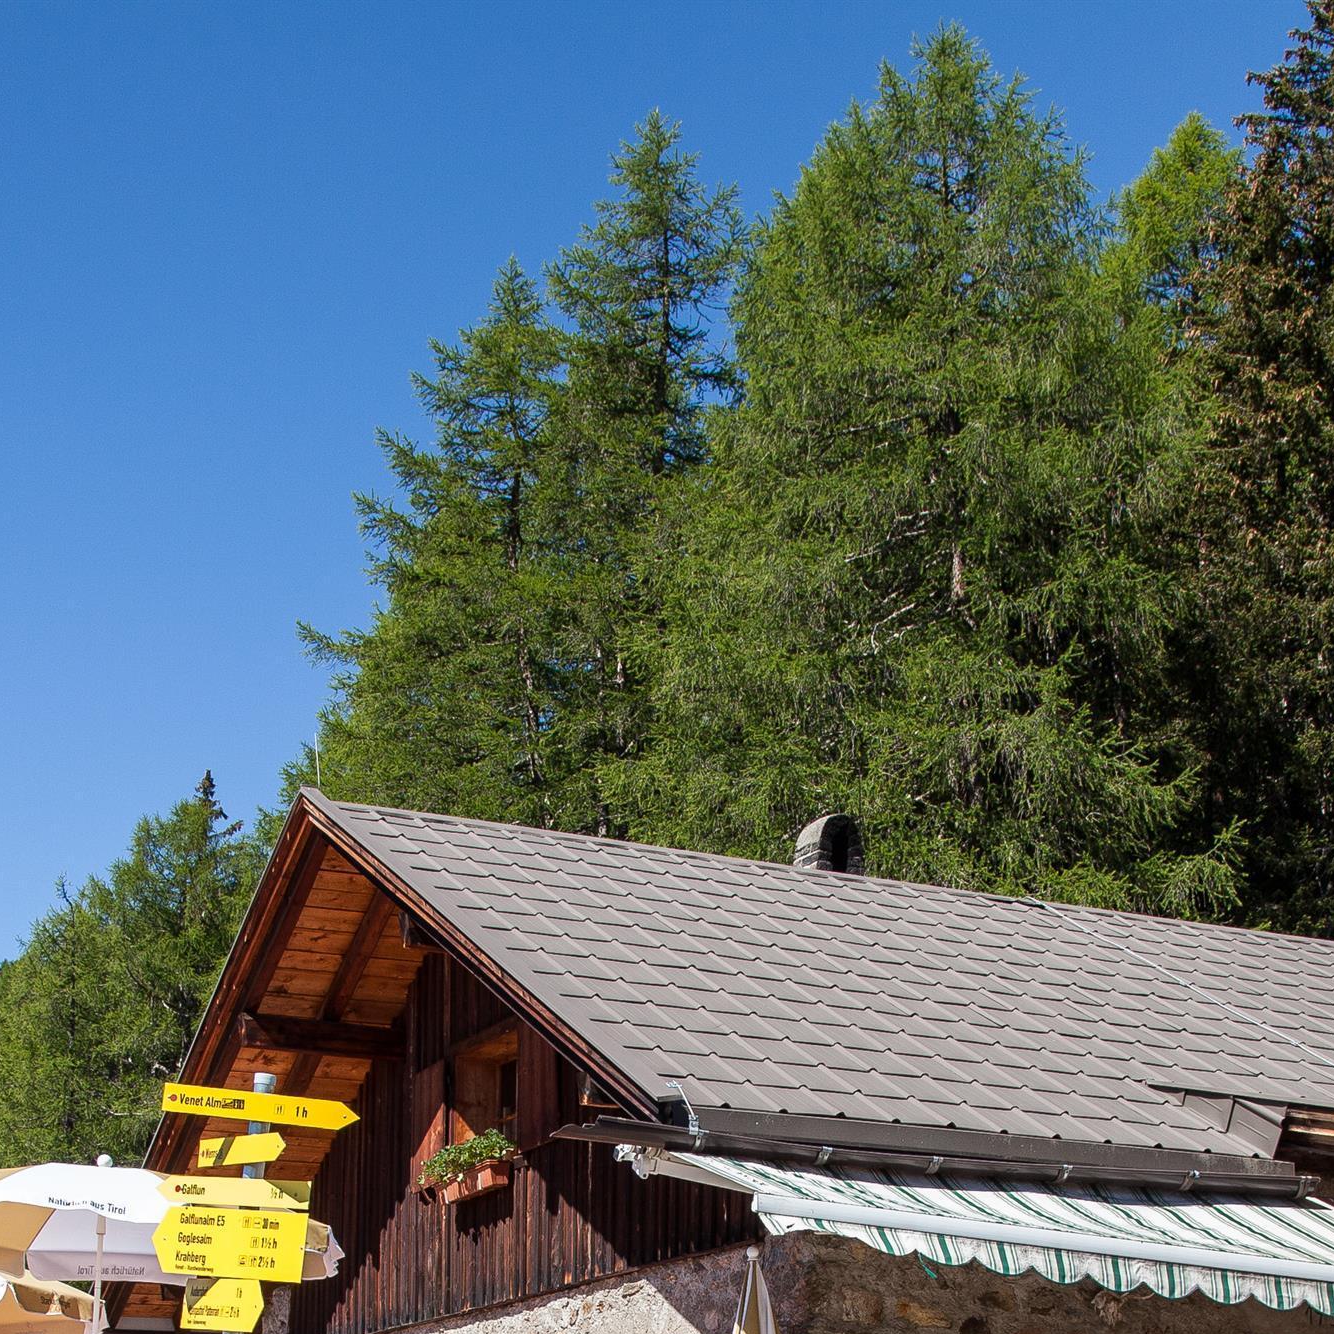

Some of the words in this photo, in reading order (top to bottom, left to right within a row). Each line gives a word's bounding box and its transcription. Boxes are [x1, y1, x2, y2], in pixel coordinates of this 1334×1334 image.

[179, 1093, 204, 1107] Venet
[205, 1096, 222, 1109] Alm
[295, 1106, 301, 1118] 1
[302, 1107, 308, 1118] h
[181, 1183, 206, 1196] Galflun
[90, 1200, 105, 1210] aus
[108, 1202, 126, 1215] Tirol
[180, 1212, 216, 1226] Galflunalm
[216, 1215, 225, 1226] E5
[269, 1219, 280, 1230] min
[177, 1231, 213, 1246] Goglesalm
[272, 1238, 278, 1249] h
[175, 1250, 207, 1266] Krahberg
[269, 1257, 276, 1269] h
